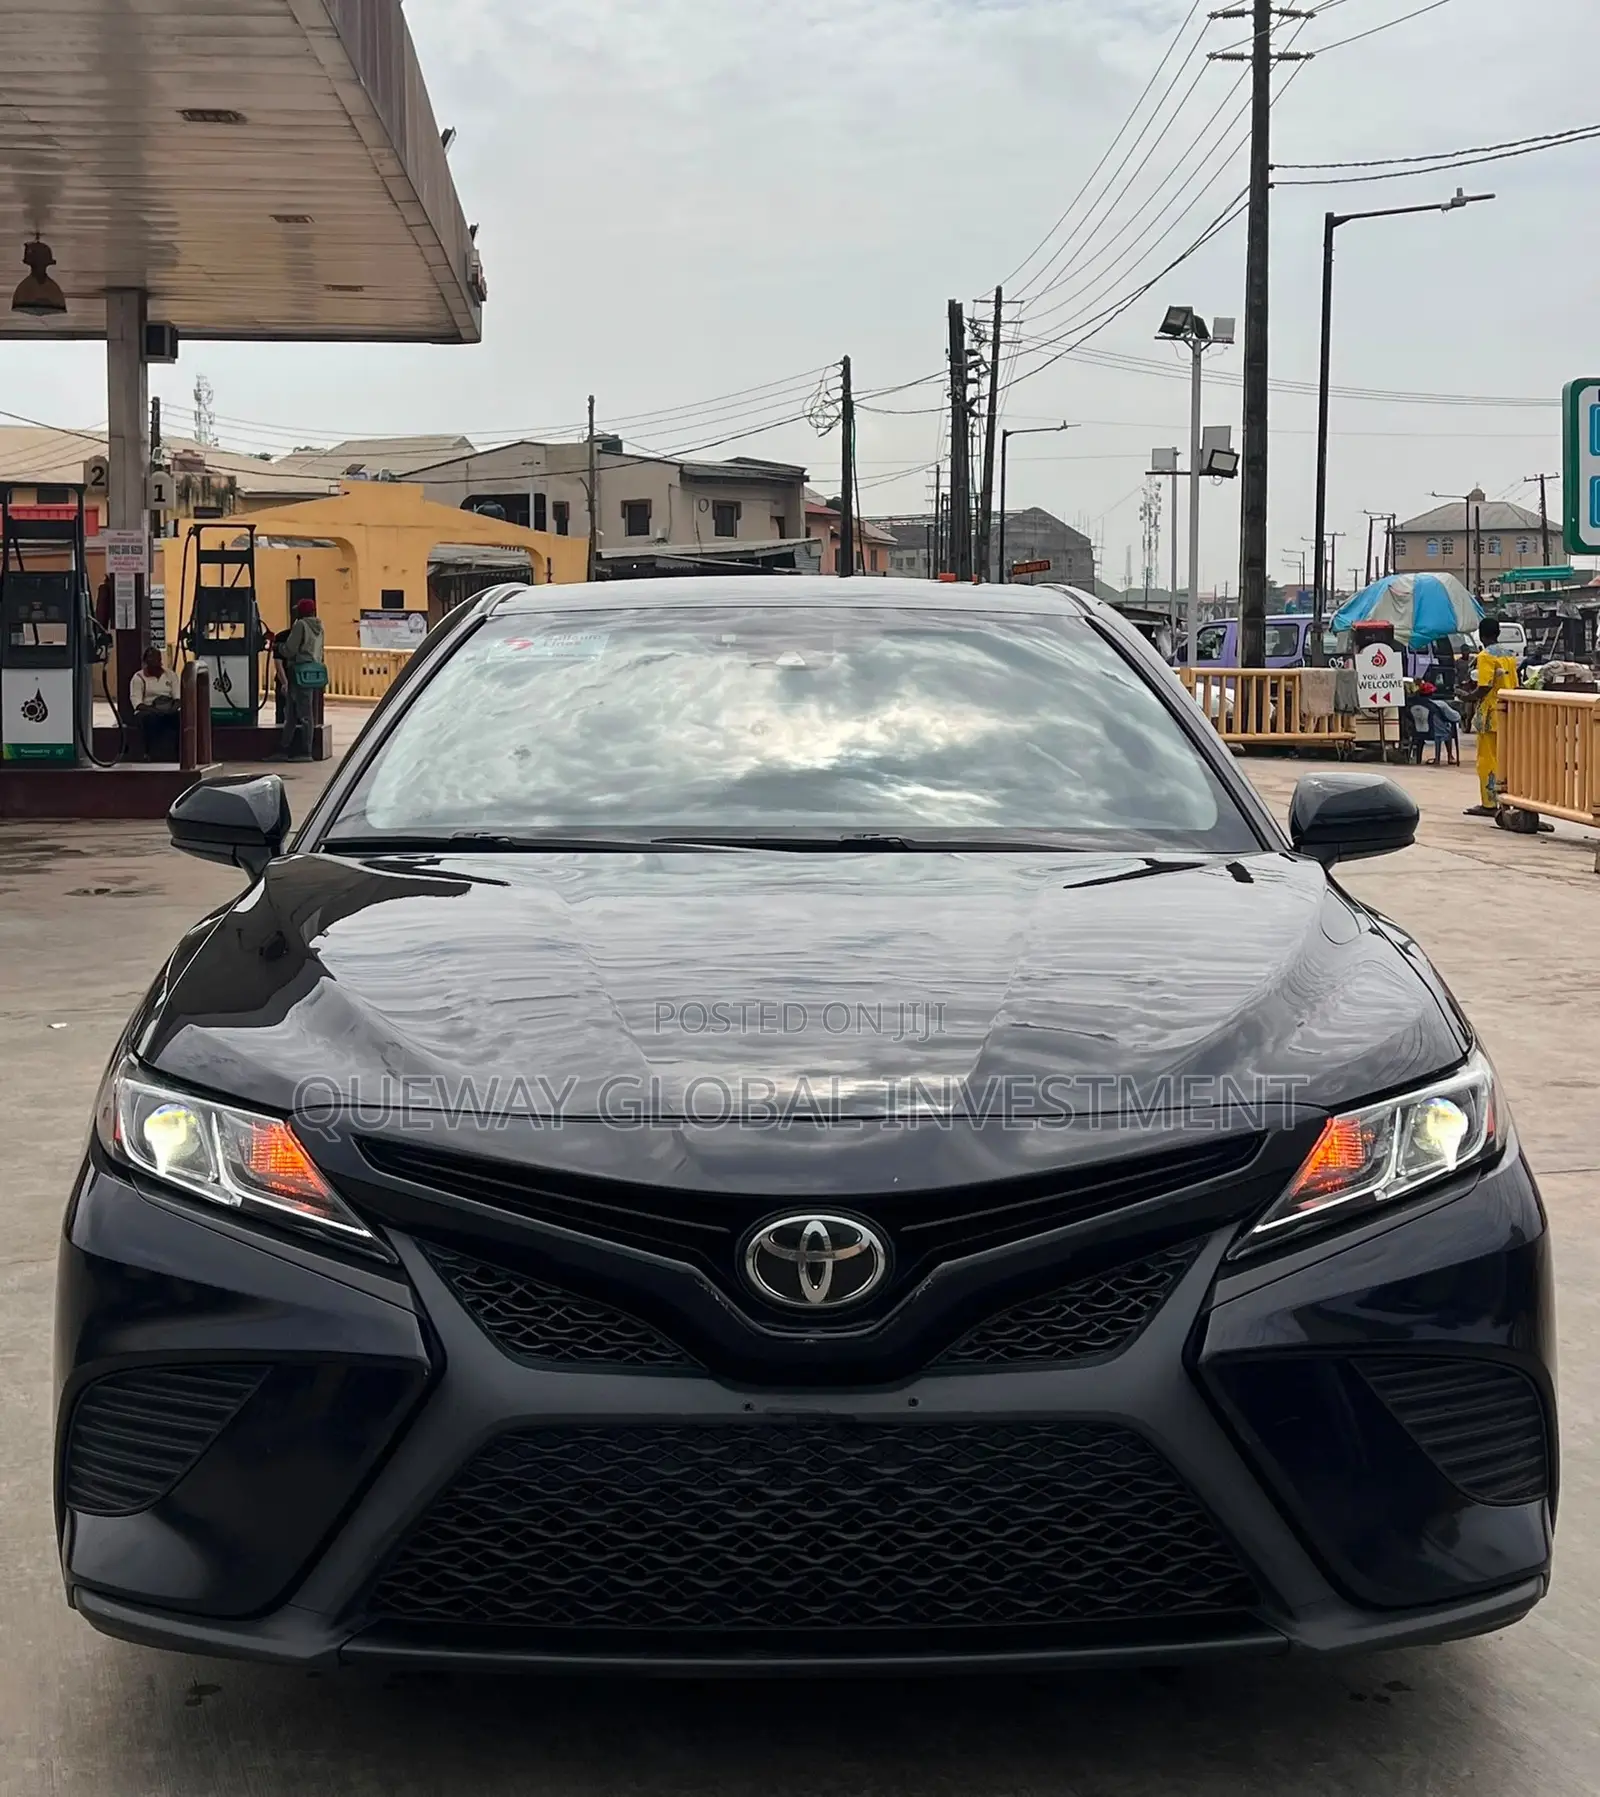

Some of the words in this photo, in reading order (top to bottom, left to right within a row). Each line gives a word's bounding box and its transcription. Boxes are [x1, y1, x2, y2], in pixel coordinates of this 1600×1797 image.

[91, 466, 105, 486] 2
[154, 484, 166, 502] 1
[1362, 673, 1378, 681] YOU
[1380, 672, 1396, 680] ARE
[1358, 680, 1403, 690] WELCOME
